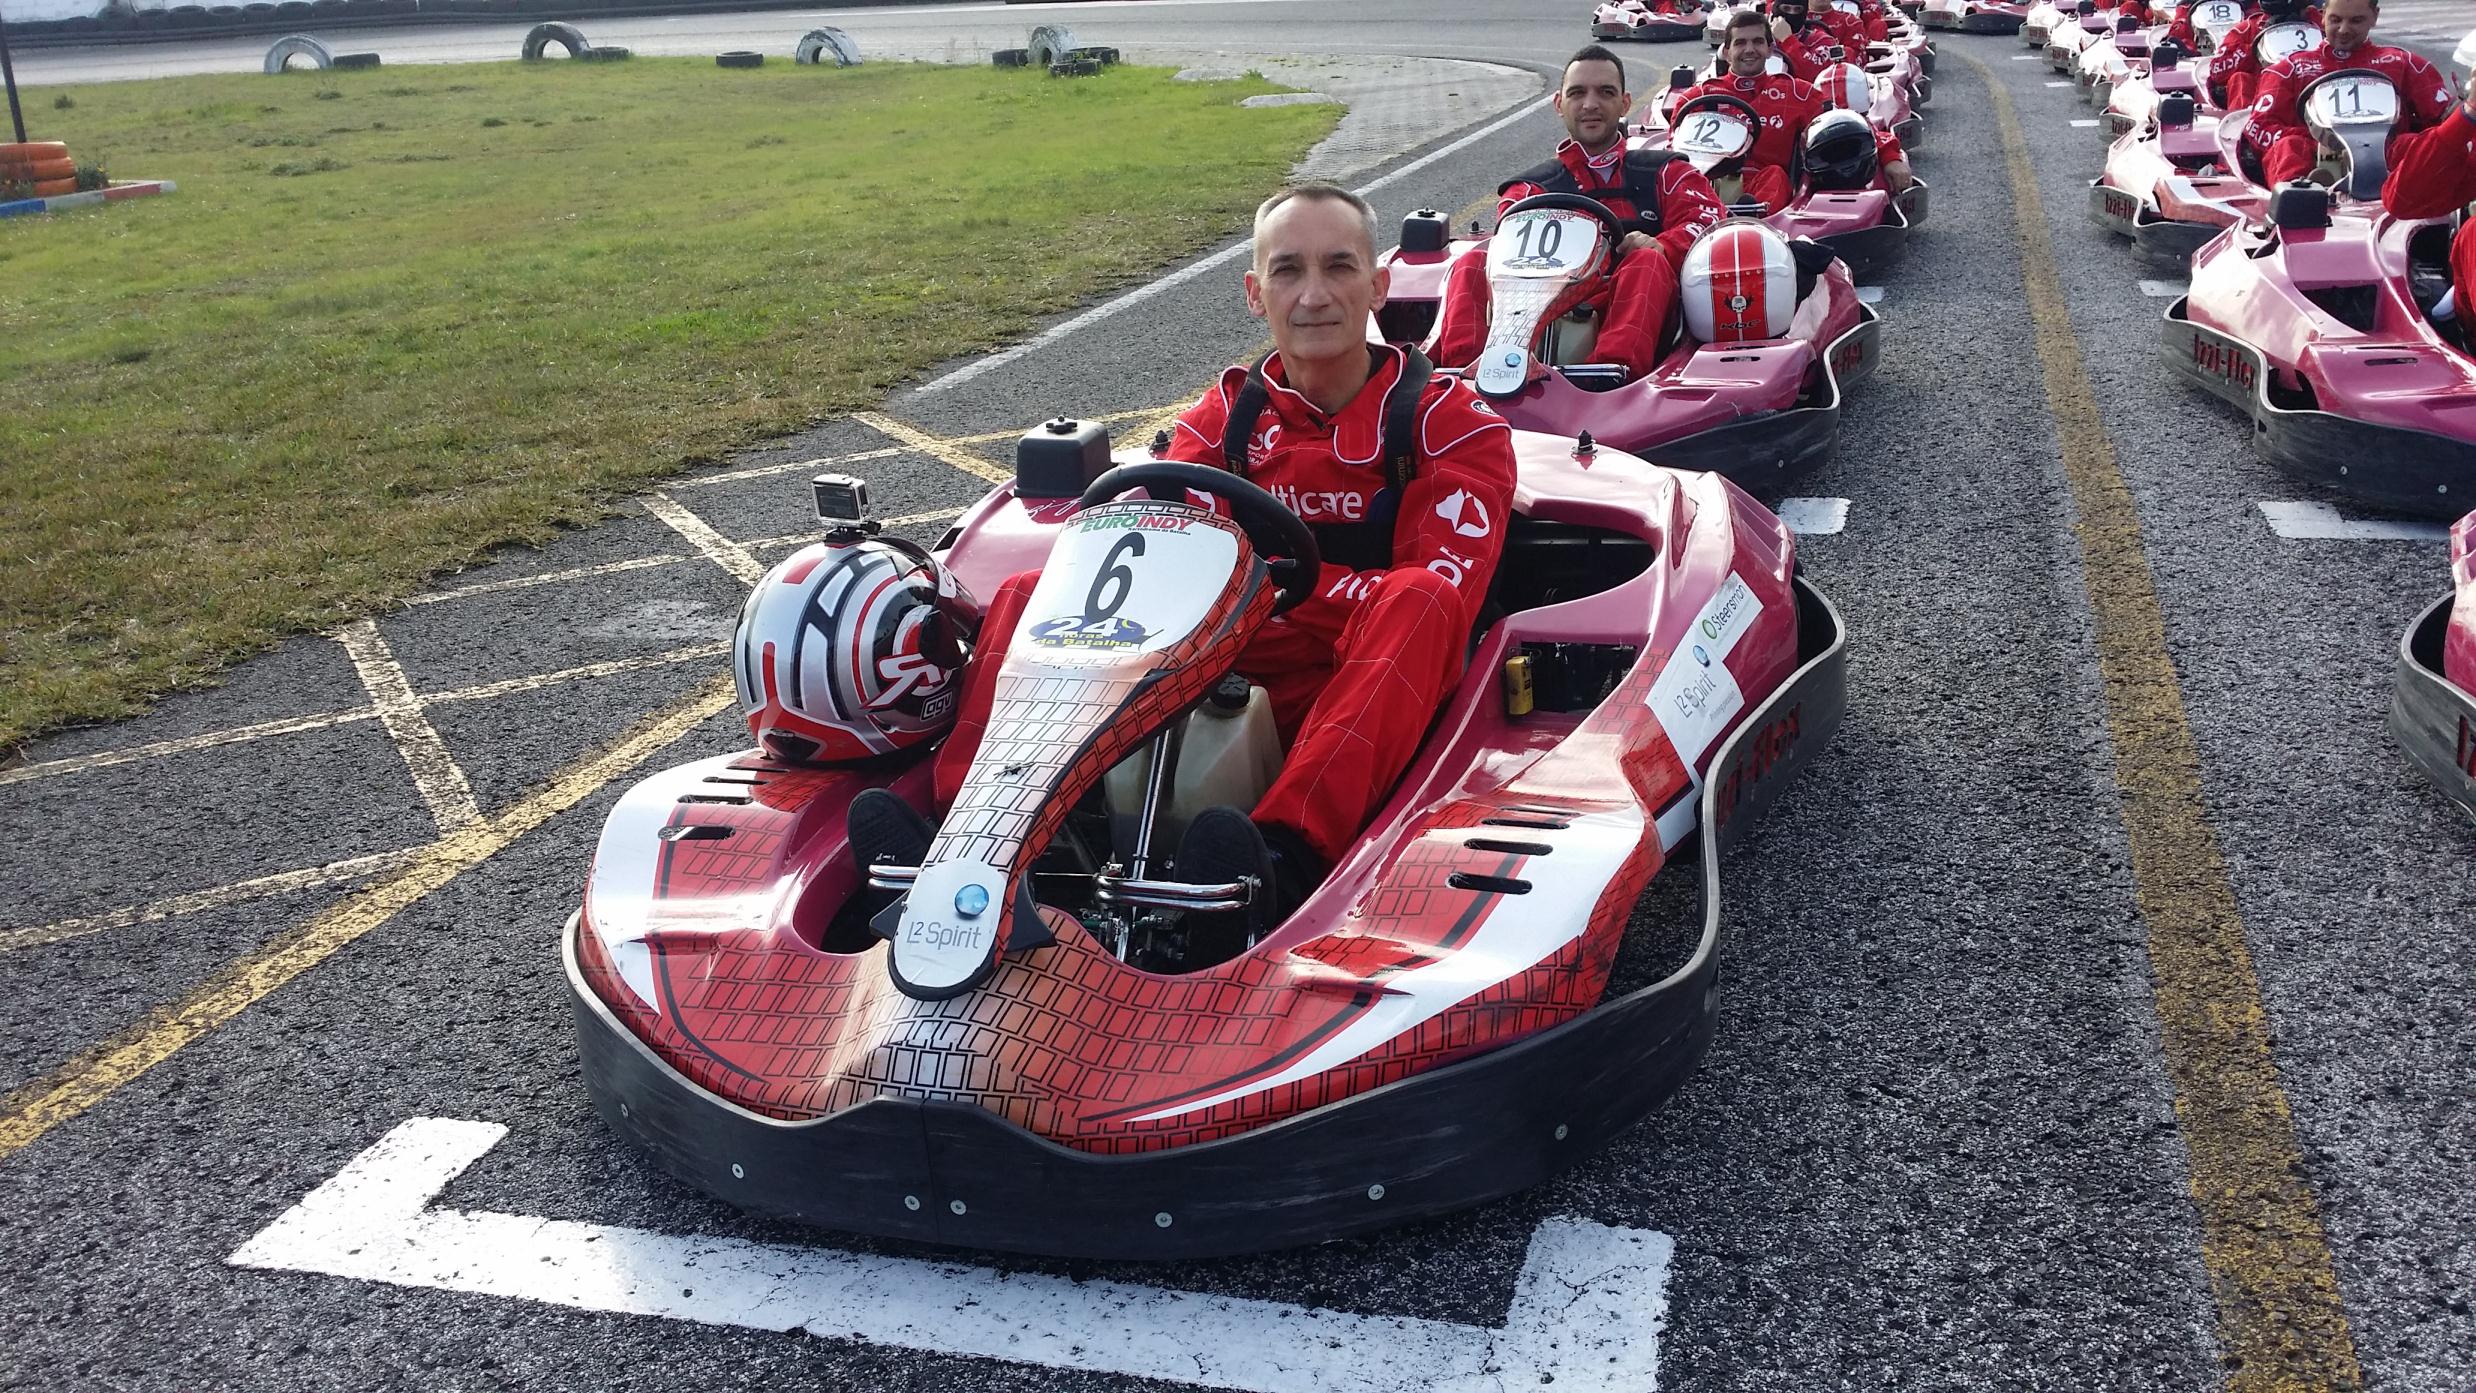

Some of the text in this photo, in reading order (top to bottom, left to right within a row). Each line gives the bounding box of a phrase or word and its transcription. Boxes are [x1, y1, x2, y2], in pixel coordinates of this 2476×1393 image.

[2208, 4, 2231, 20] 18
[2294, 29, 2308, 50] 3
[2327, 83, 2361, 116] 11
[1693, 118, 1721, 143] 12
[1516, 219, 1562, 259] 10
[1492, 368, 1520, 380] Spirit
[1080, 515, 1193, 534] EUROINDY
[1084, 531, 1146, 623] 6
[1062, 638, 1132, 648] Batalha
[1683, 670, 1717, 708] Spirit
[925, 921, 983, 950] Spirit
